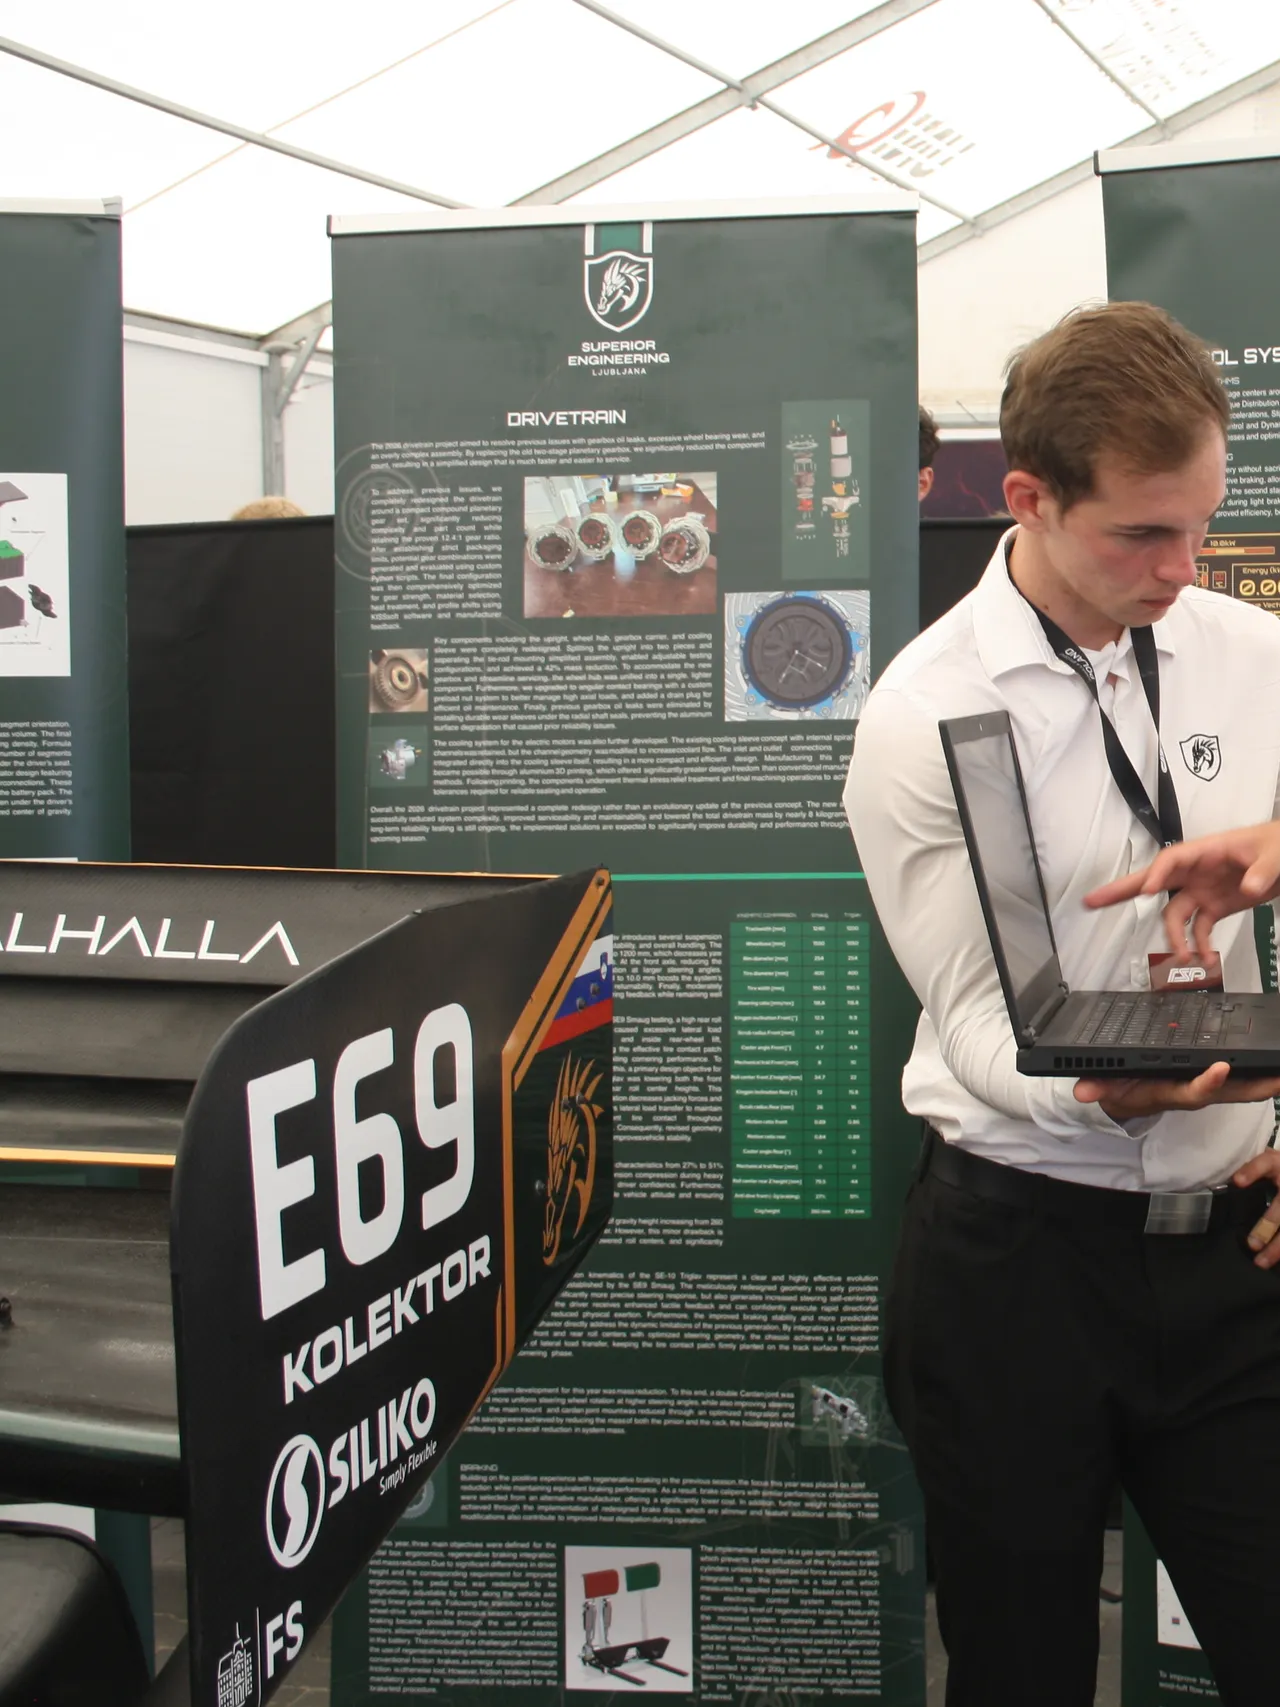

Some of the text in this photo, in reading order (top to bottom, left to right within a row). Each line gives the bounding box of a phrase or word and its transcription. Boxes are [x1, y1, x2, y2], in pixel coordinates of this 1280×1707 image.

[582, 340, 656, 353] SUPERIOR
[568, 352, 670, 366] ENGINEERING
[592, 367, 647, 376] LJUBLJANA
[1242, 387, 1267, 396] centers
[1242, 398, 1280, 408] Distribution
[507, 409, 627, 427] DRIVETRAIN
[1242, 567, 1268, 575] Energy
[1064, 647, 1096, 680] POLAND
[40, 730, 55, 738] The
[11, 788, 73, 798] battery pack. The
[47, 808, 72, 817] gravity.
[0, 912, 300, 967] LHALLA
[247, 1002, 475, 1320] E69
[282, 1234, 492, 1404] KOLEKTOR
[328, 1377, 436, 1509] SILIKO
[380, 1439, 438, 1496] Simply Flexible
[266, 1600, 304, 1679] FS
